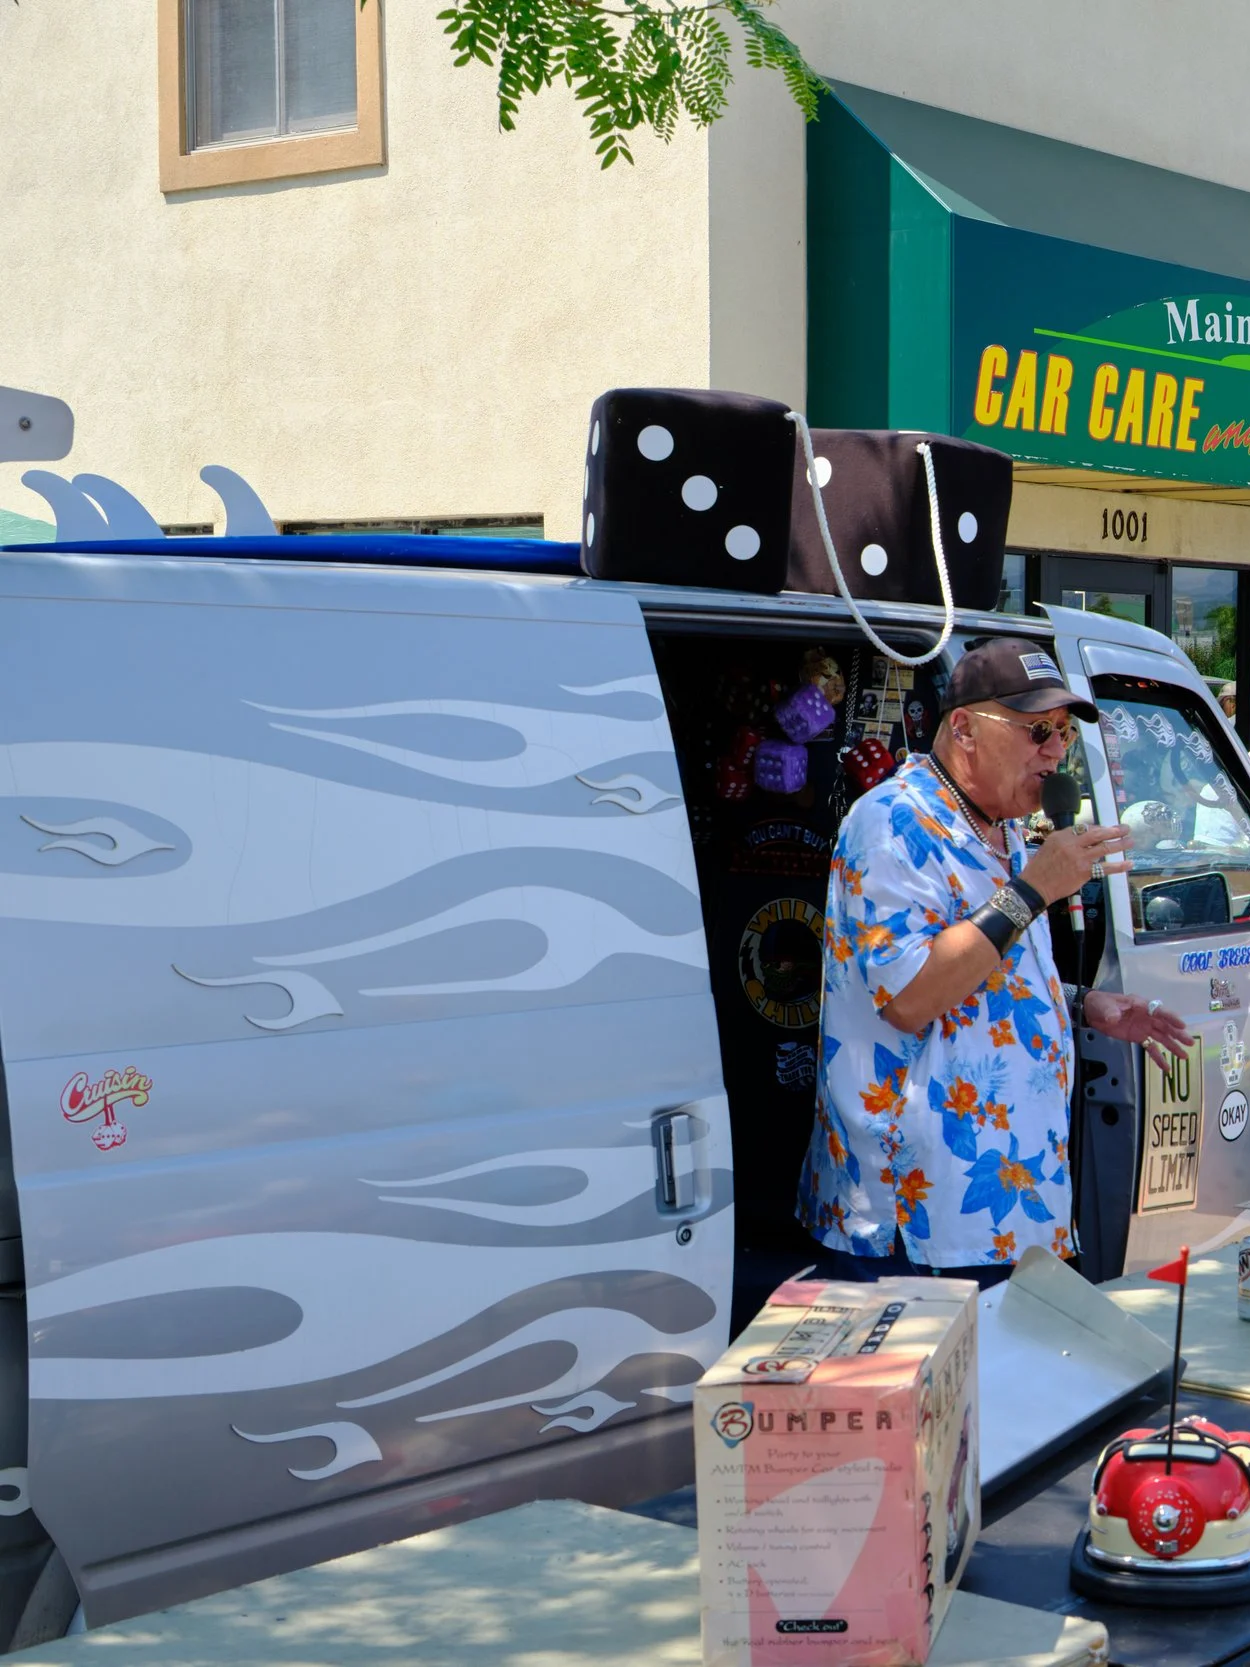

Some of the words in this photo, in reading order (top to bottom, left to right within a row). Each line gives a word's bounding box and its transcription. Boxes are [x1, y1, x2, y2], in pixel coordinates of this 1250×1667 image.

[975, 345, 1073, 434] CAR
[1089, 363, 1204, 452] CARE
[1101, 508, 1149, 543] 1001
[743, 825, 767, 849] YOU
[767, 822, 802, 841] CAN'T
[803, 828, 828, 853] BUY
[1181, 951, 1213, 974] COOL
[60, 1066, 154, 1122] Cruisin
[1161, 1050, 1190, 1104] NO
[1152, 1112, 1198, 1148] SPEED
[1221, 1103, 1247, 1128] OKAY
[1148, 1152, 1196, 1195] LIMIT
[861, 1303, 906, 1353] RADIO
[764, 1464, 807, 1475] Bumper
[812, 1464, 834, 1473] Car
[837, 1462, 870, 1474] styled
[874, 1463, 903, 1472] radio
[767, 1448, 799, 1460] Party
[802, 1449, 812, 1457] to
[814, 1451, 841, 1461] your
[727, 1559, 744, 1569] AC
